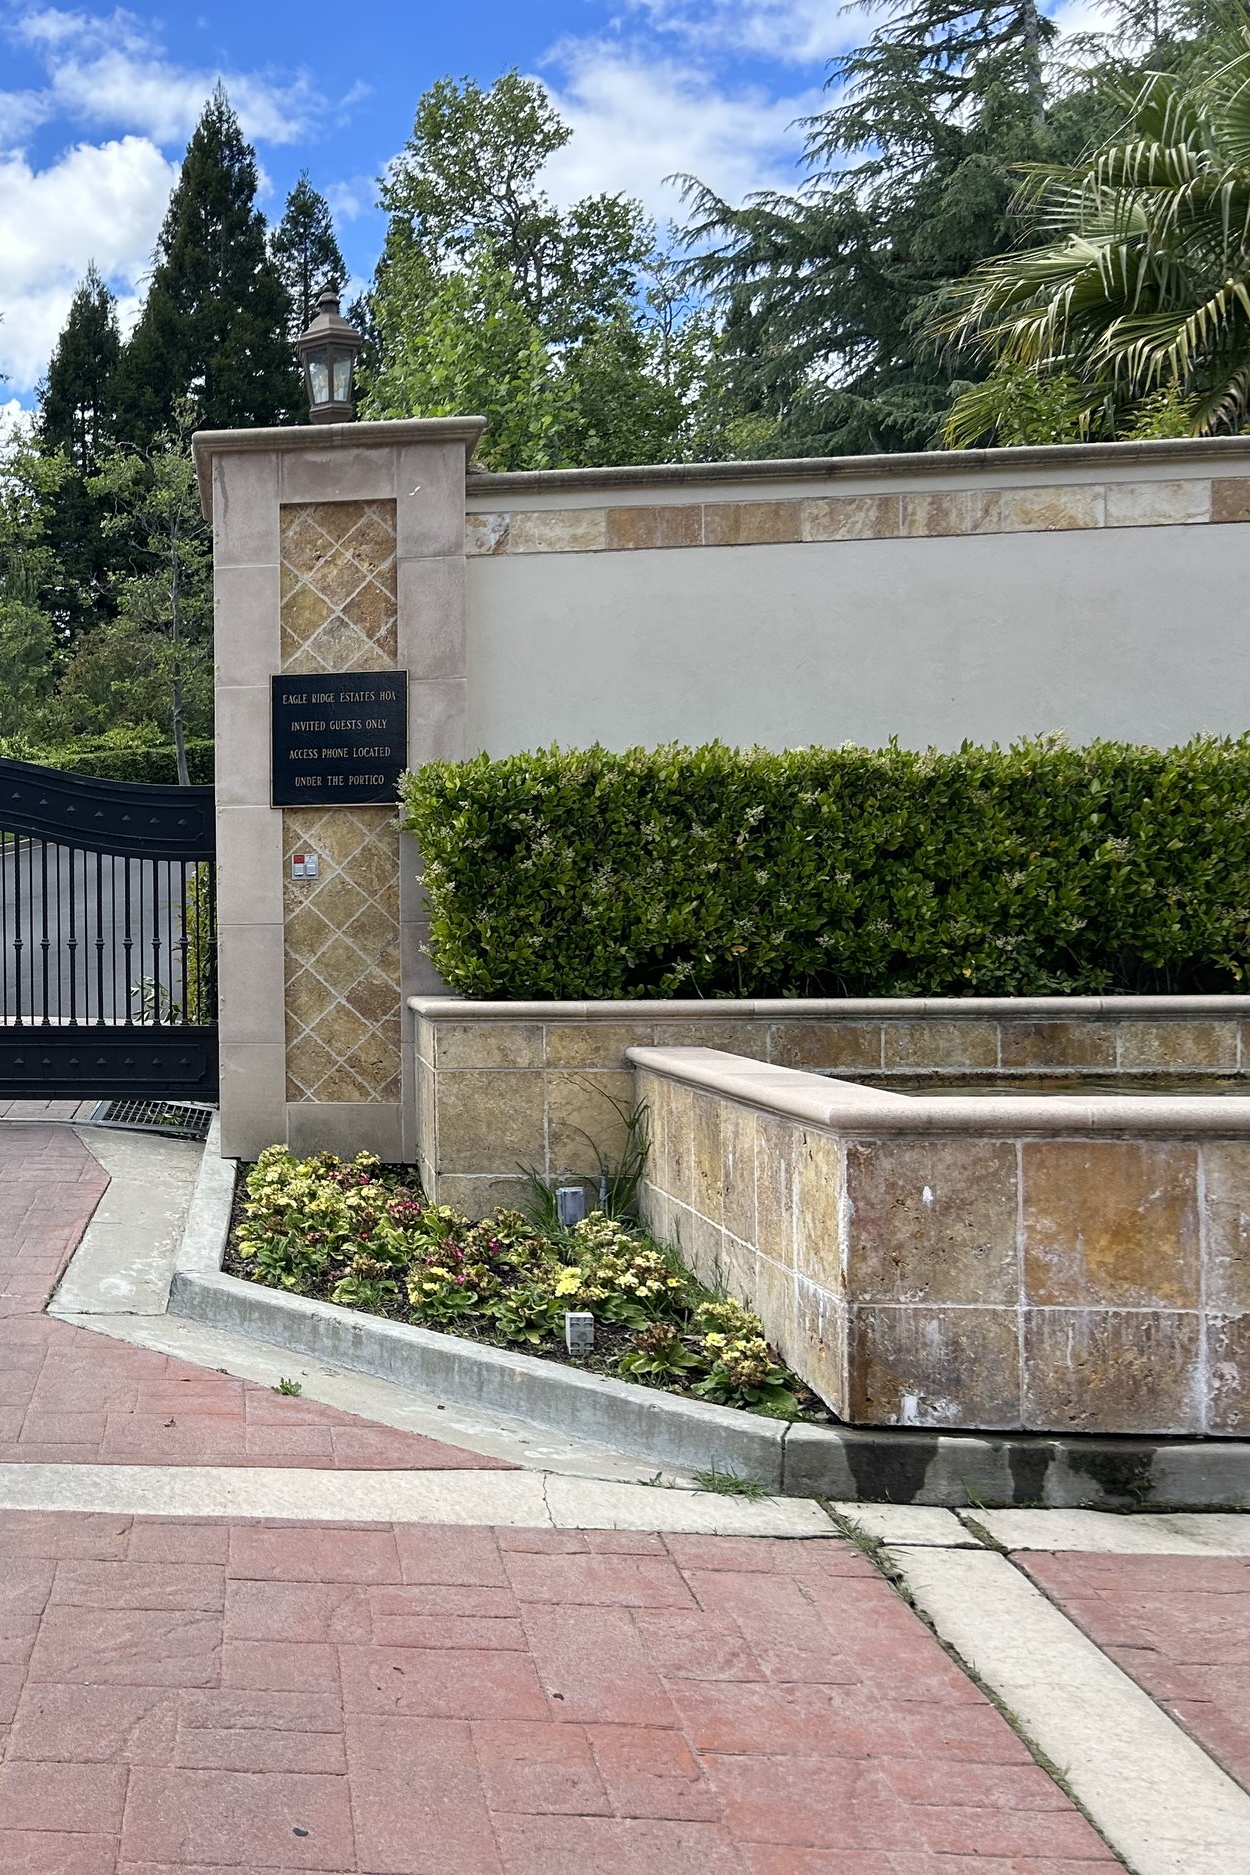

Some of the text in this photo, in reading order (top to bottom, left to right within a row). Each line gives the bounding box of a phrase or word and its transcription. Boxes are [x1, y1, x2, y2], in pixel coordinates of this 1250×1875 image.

[282, 691, 396, 704] EAGLE RIDGE ESTATES HOA
[291, 719, 388, 732] INVITED GUESTS ONLY
[289, 747, 391, 759] ACCESS PHONE LOCATED
[295, 775, 384, 786] UNDER THE PORTICO
